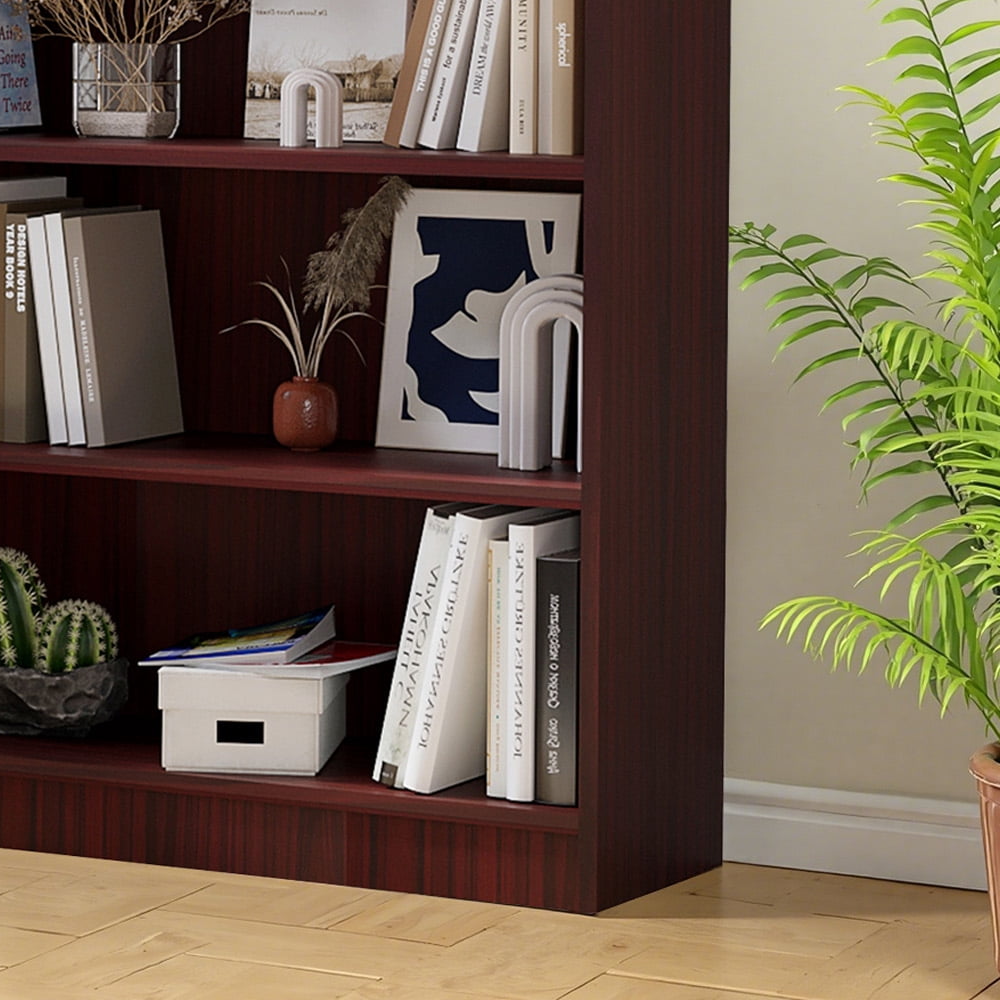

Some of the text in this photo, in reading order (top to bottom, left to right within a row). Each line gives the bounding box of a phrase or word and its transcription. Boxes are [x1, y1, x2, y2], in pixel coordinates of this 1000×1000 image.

[428, 13, 444, 47] GOOD
[422, 57, 432, 69] IS
[425, 48, 435, 57] A
[443, 55, 453, 69] for
[1, 74, 29, 89] There
[416, 70, 429, 92] THIS
[472, 55, 488, 96] DREAM
[2, 98, 32, 113] Twice
[6, 224, 15, 254] YEAR
[5, 257, 14, 292] BOOK
[16, 224, 26, 313] DESIGN HOTELS
